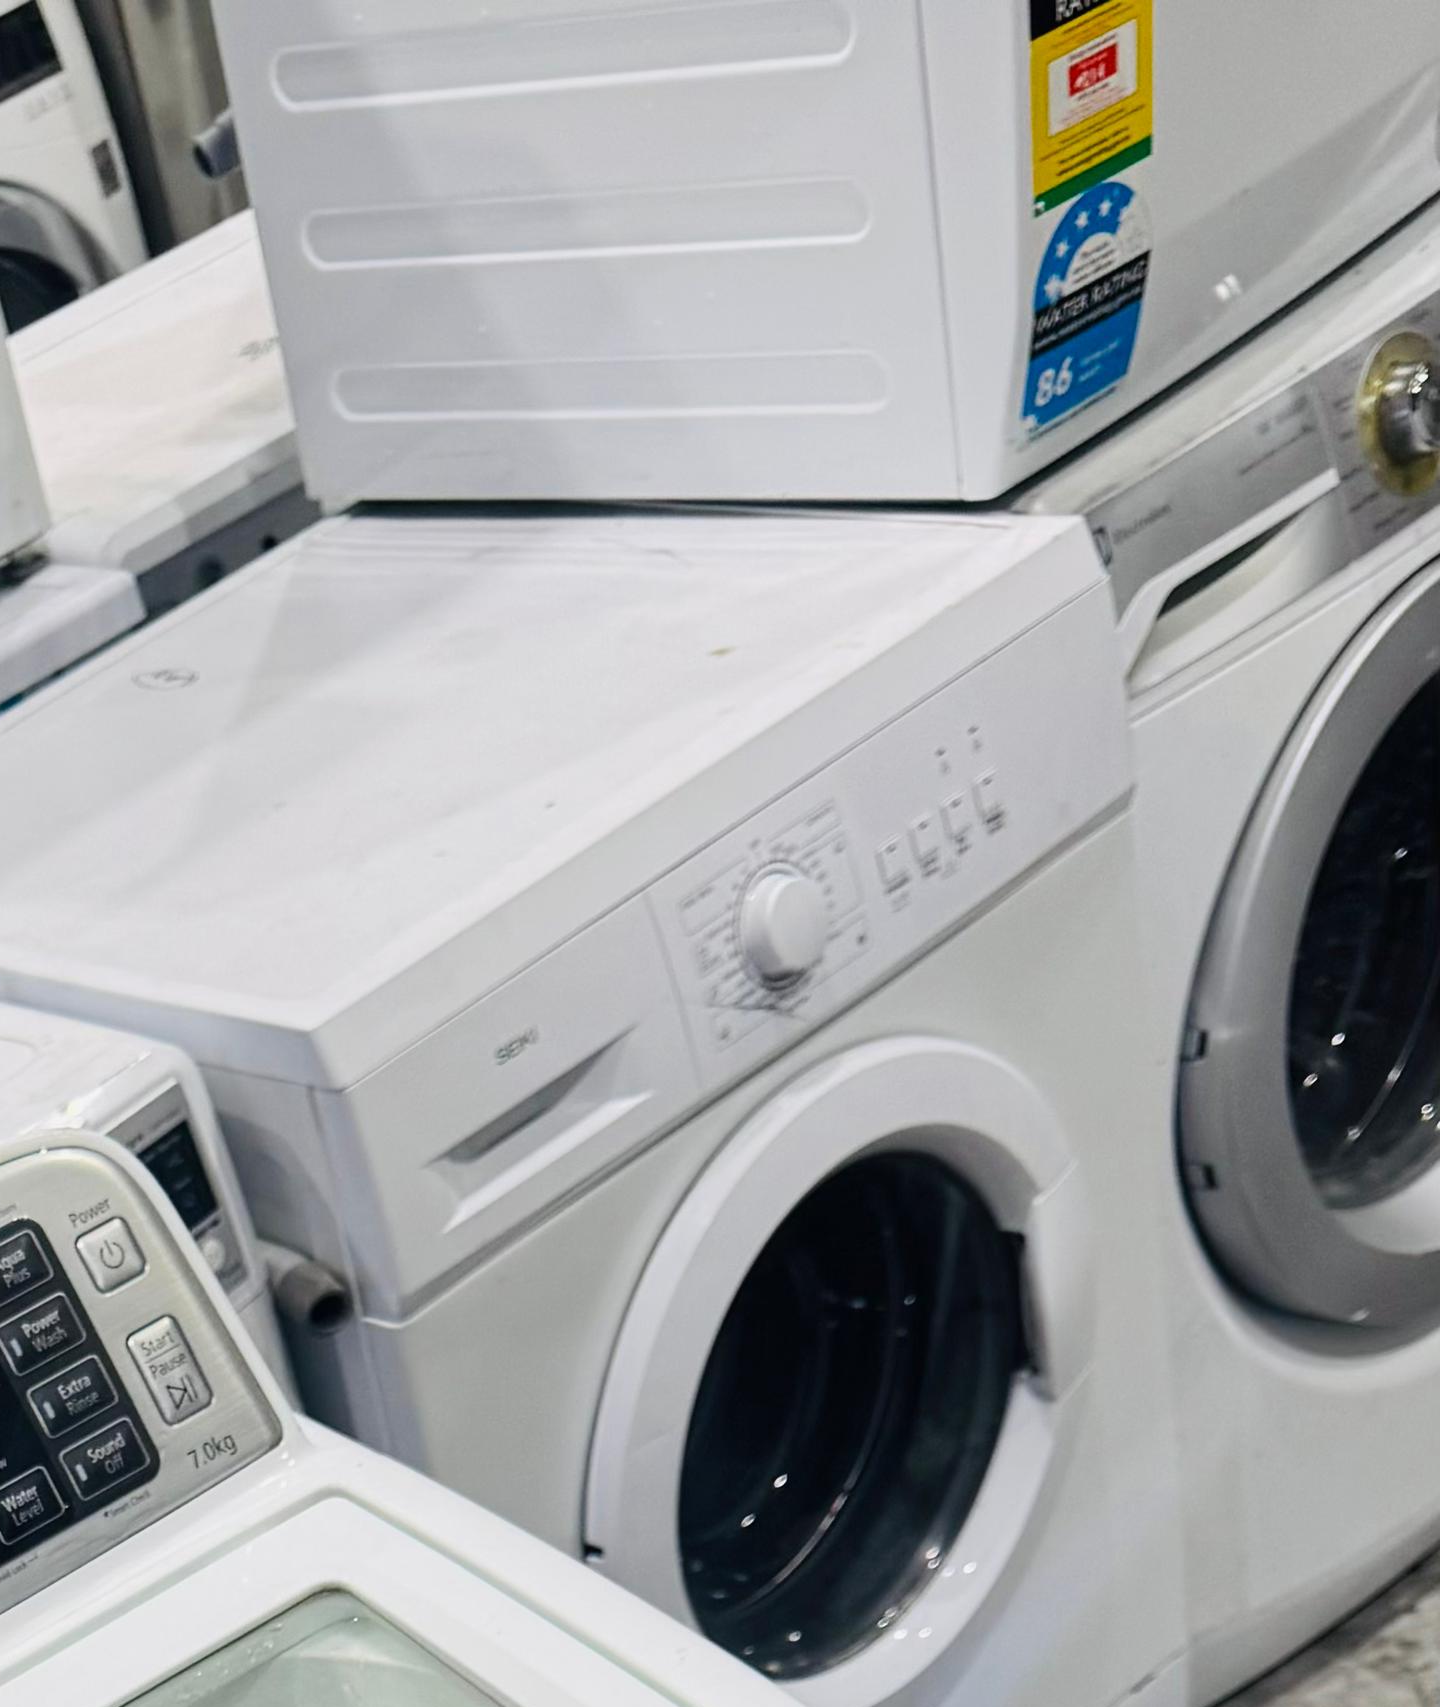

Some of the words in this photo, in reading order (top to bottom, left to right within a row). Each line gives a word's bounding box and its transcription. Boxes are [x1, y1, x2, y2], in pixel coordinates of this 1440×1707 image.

[1034, 356, 1073, 407] 86
[68, 1198, 111, 1228] Power
[3, 1266, 32, 1288] Plus
[21, 1310, 61, 1338] Power
[32, 1326, 68, 1352] Wash
[140, 1330, 176, 1357] Start
[149, 1352, 188, 1379] Pause
[57, 1375, 92, 1400] Extra
[65, 1391, 100, 1416] Rinse
[86, 1432, 127, 1464] Sound
[186, 1434, 238, 1470] 7.0kg
[104, 1452, 125, 1474] Off
[0, 1485, 38, 1513] Water
[11, 1497, 45, 1526] Level
